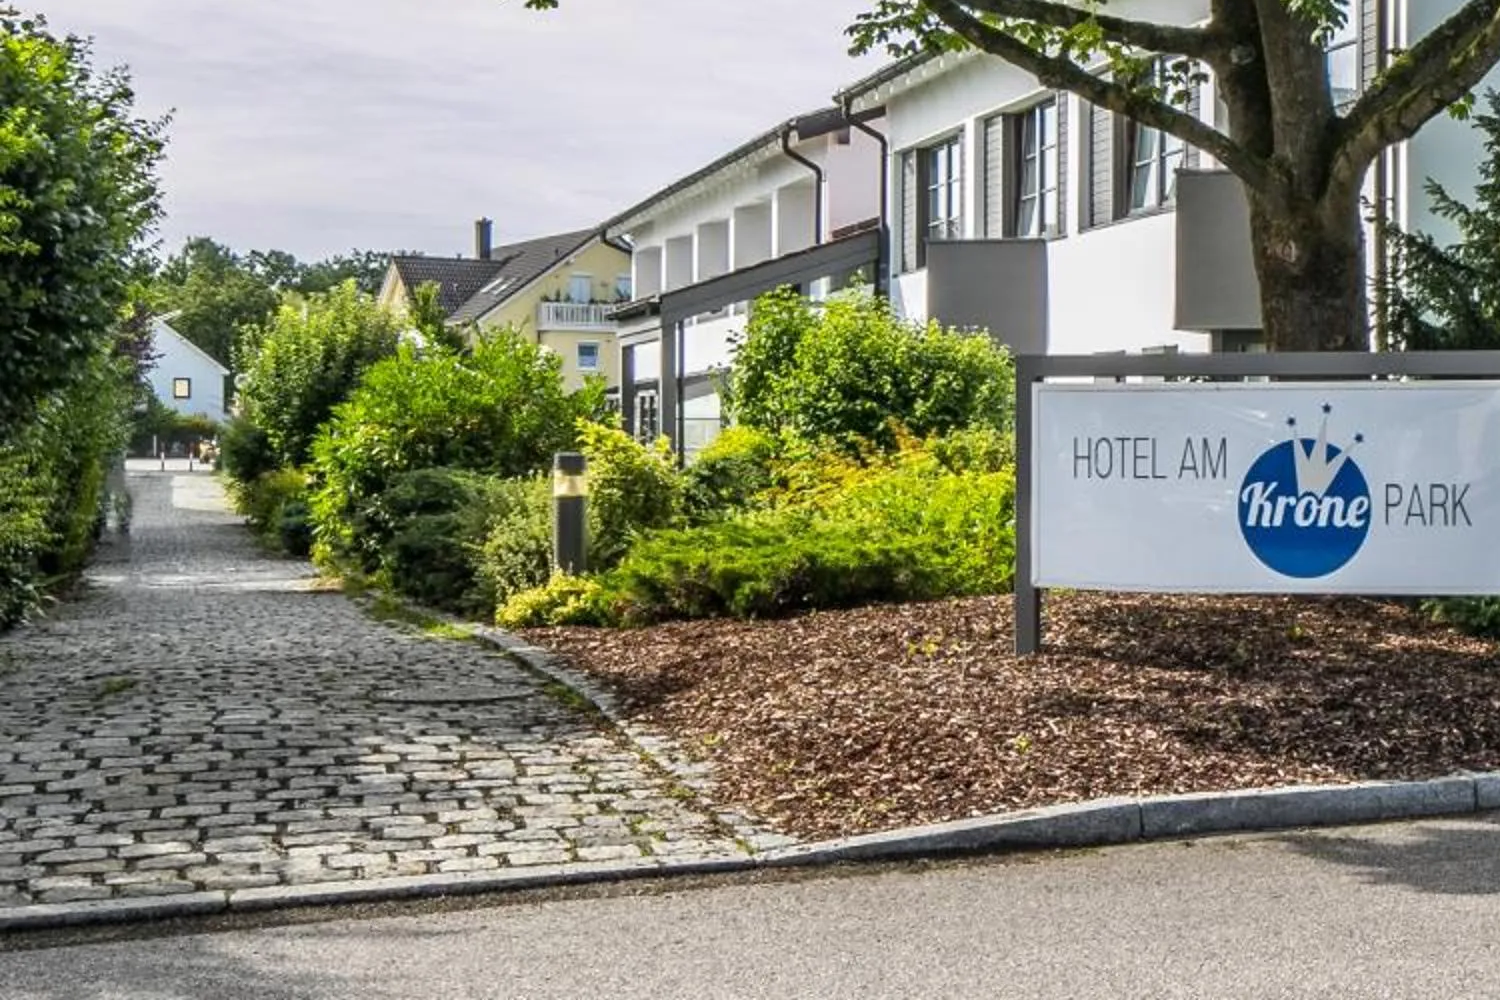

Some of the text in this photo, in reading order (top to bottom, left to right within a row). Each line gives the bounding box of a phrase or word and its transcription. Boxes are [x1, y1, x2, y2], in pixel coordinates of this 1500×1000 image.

[1073, 437, 1227, 480] HOTEL AM
[1241, 481, 1472, 529] Krone PARK
